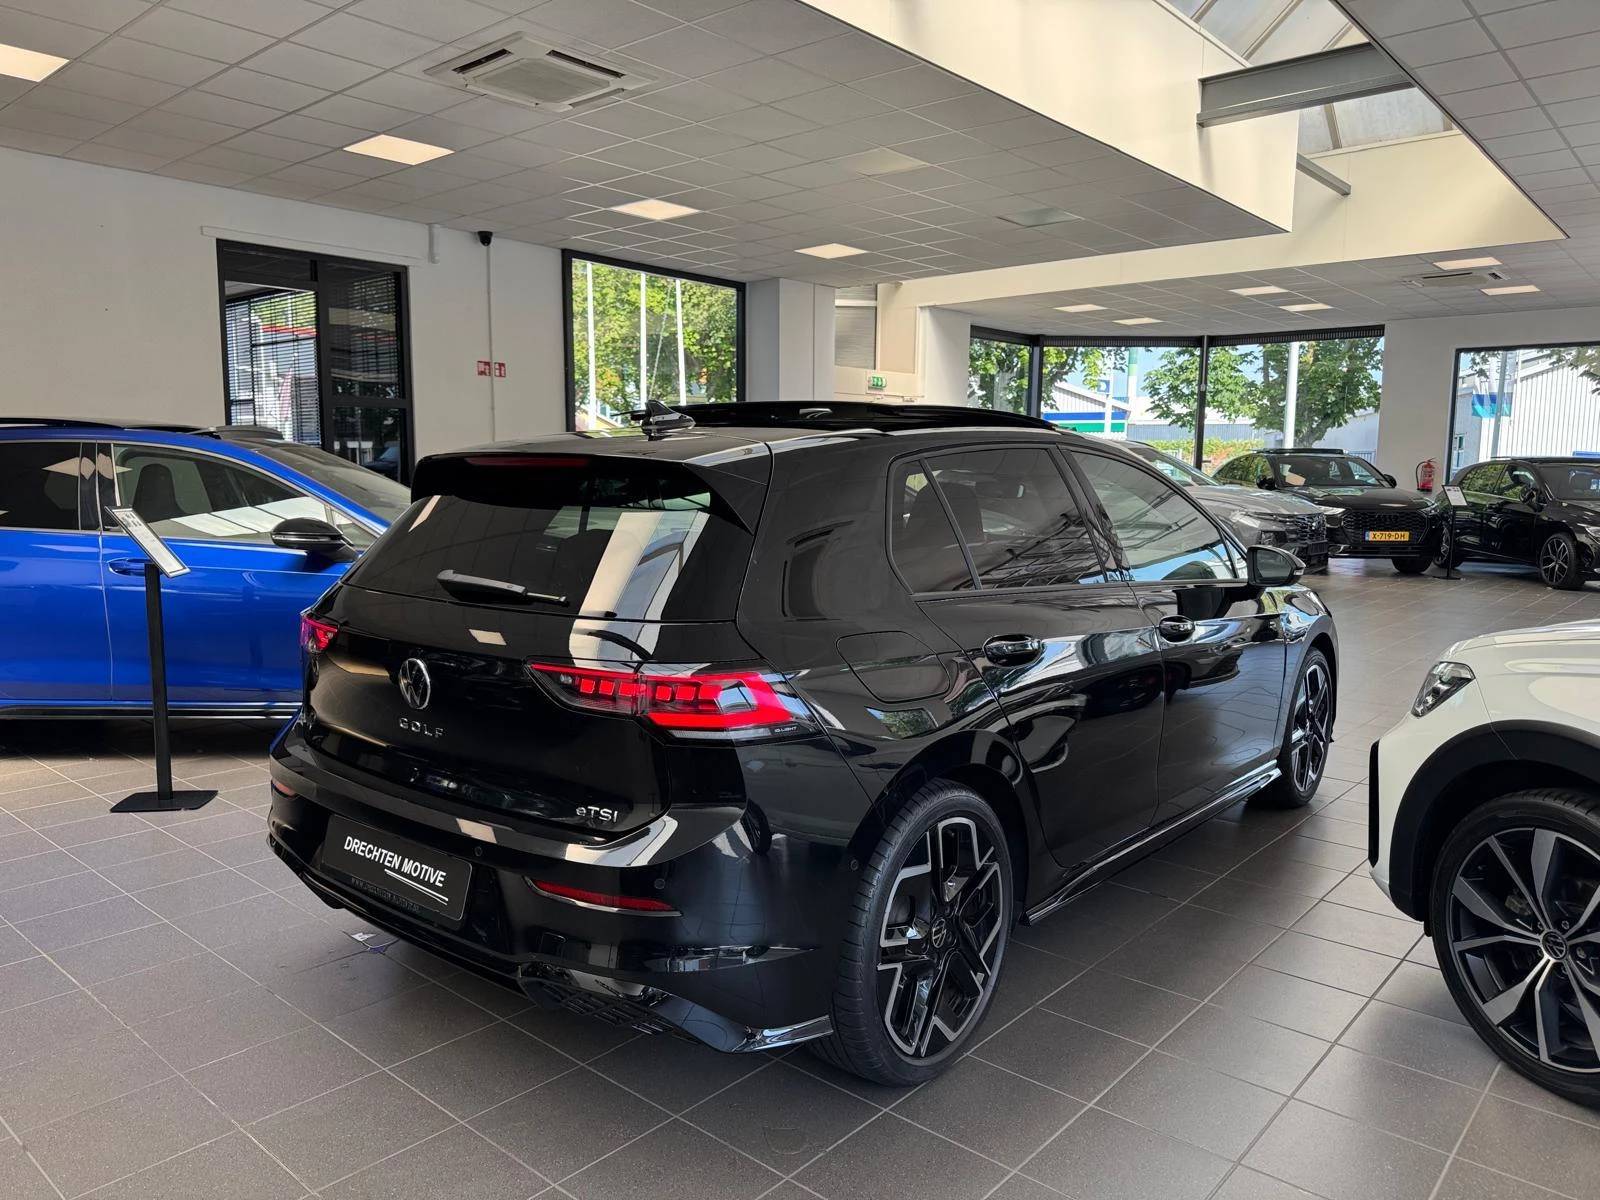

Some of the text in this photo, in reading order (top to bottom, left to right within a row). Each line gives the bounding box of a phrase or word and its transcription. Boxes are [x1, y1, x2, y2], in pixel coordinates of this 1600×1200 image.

[1371, 532, 1405, 540] X-719-DH
[400, 717, 444, 738] GOLF
[576, 806, 618, 823] eTSI
[344, 836, 446, 887] DRECHTEN MOTIVE
